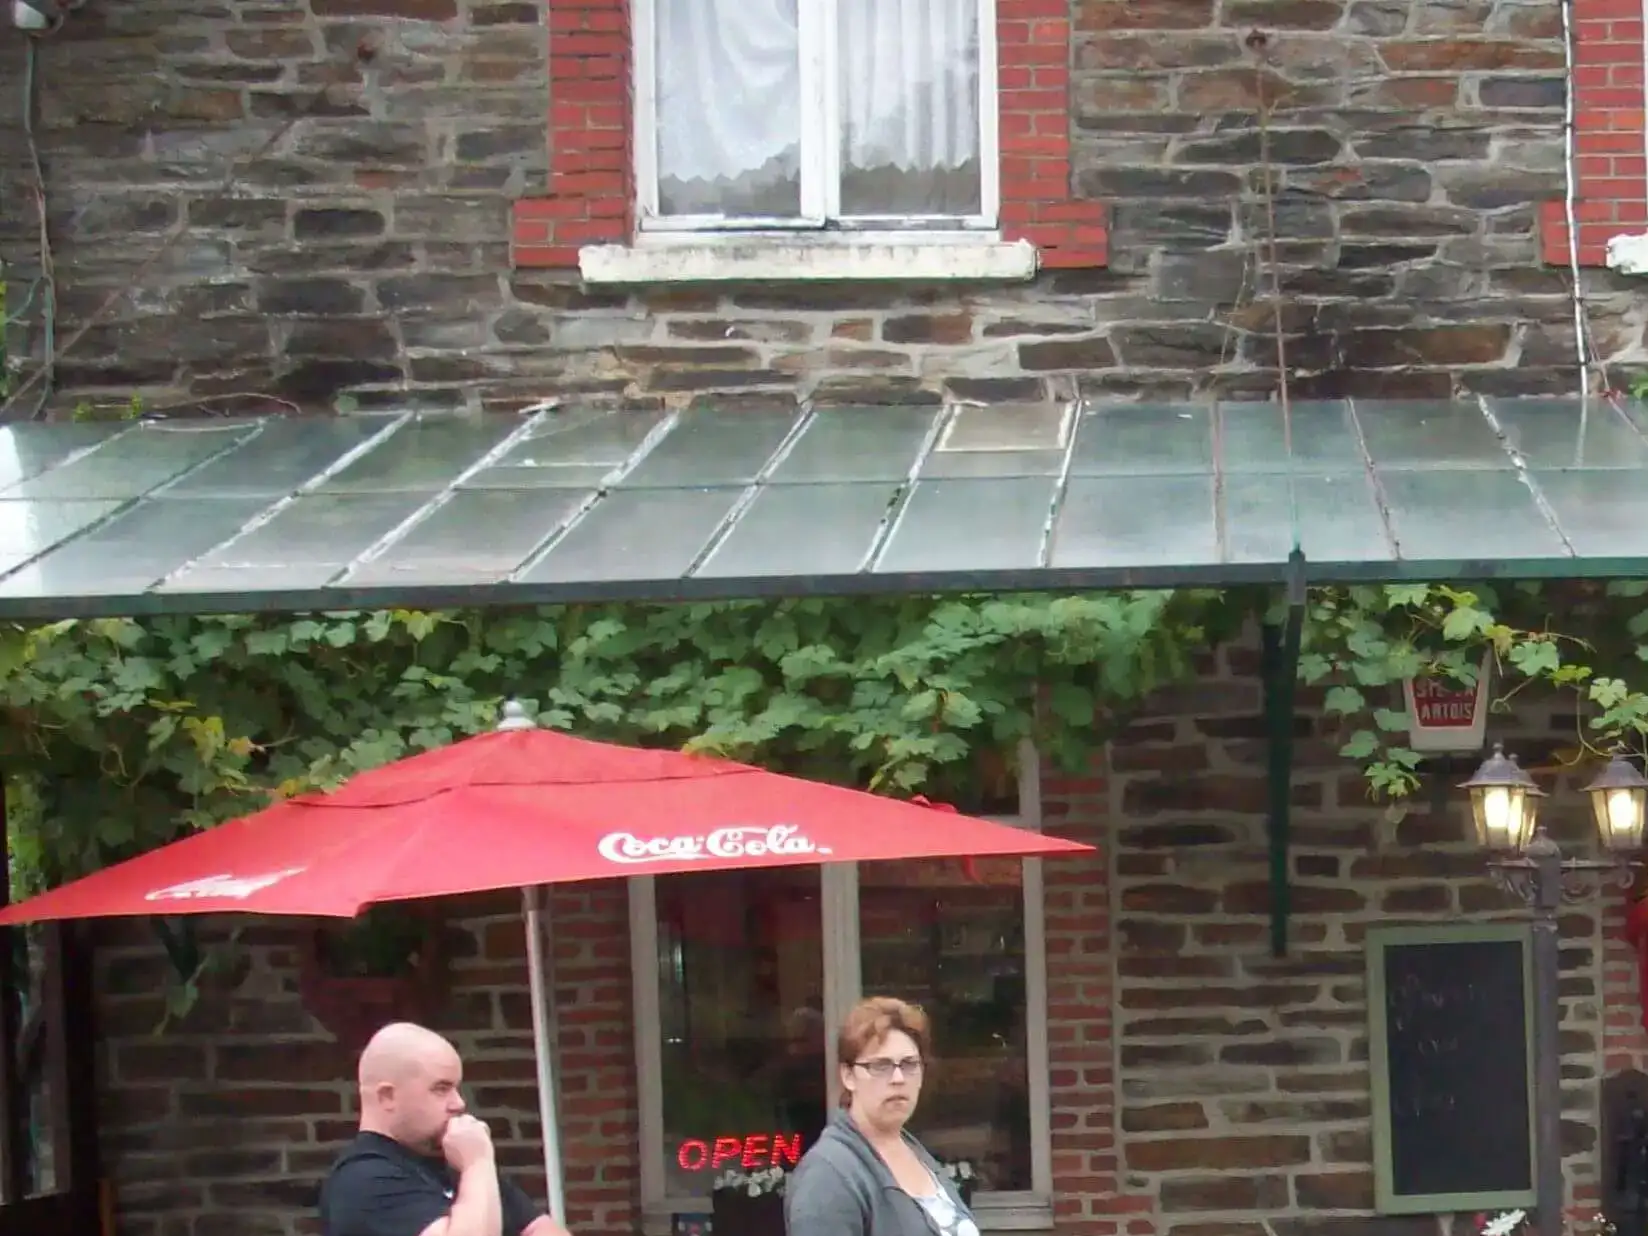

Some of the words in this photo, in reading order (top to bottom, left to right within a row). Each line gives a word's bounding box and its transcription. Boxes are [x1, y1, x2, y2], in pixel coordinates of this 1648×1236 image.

[1421, 702, 1473, 720] ARTOIS
[597, 824, 817, 864] Coca-Cola
[677, 1133, 803, 1171] OPEN
